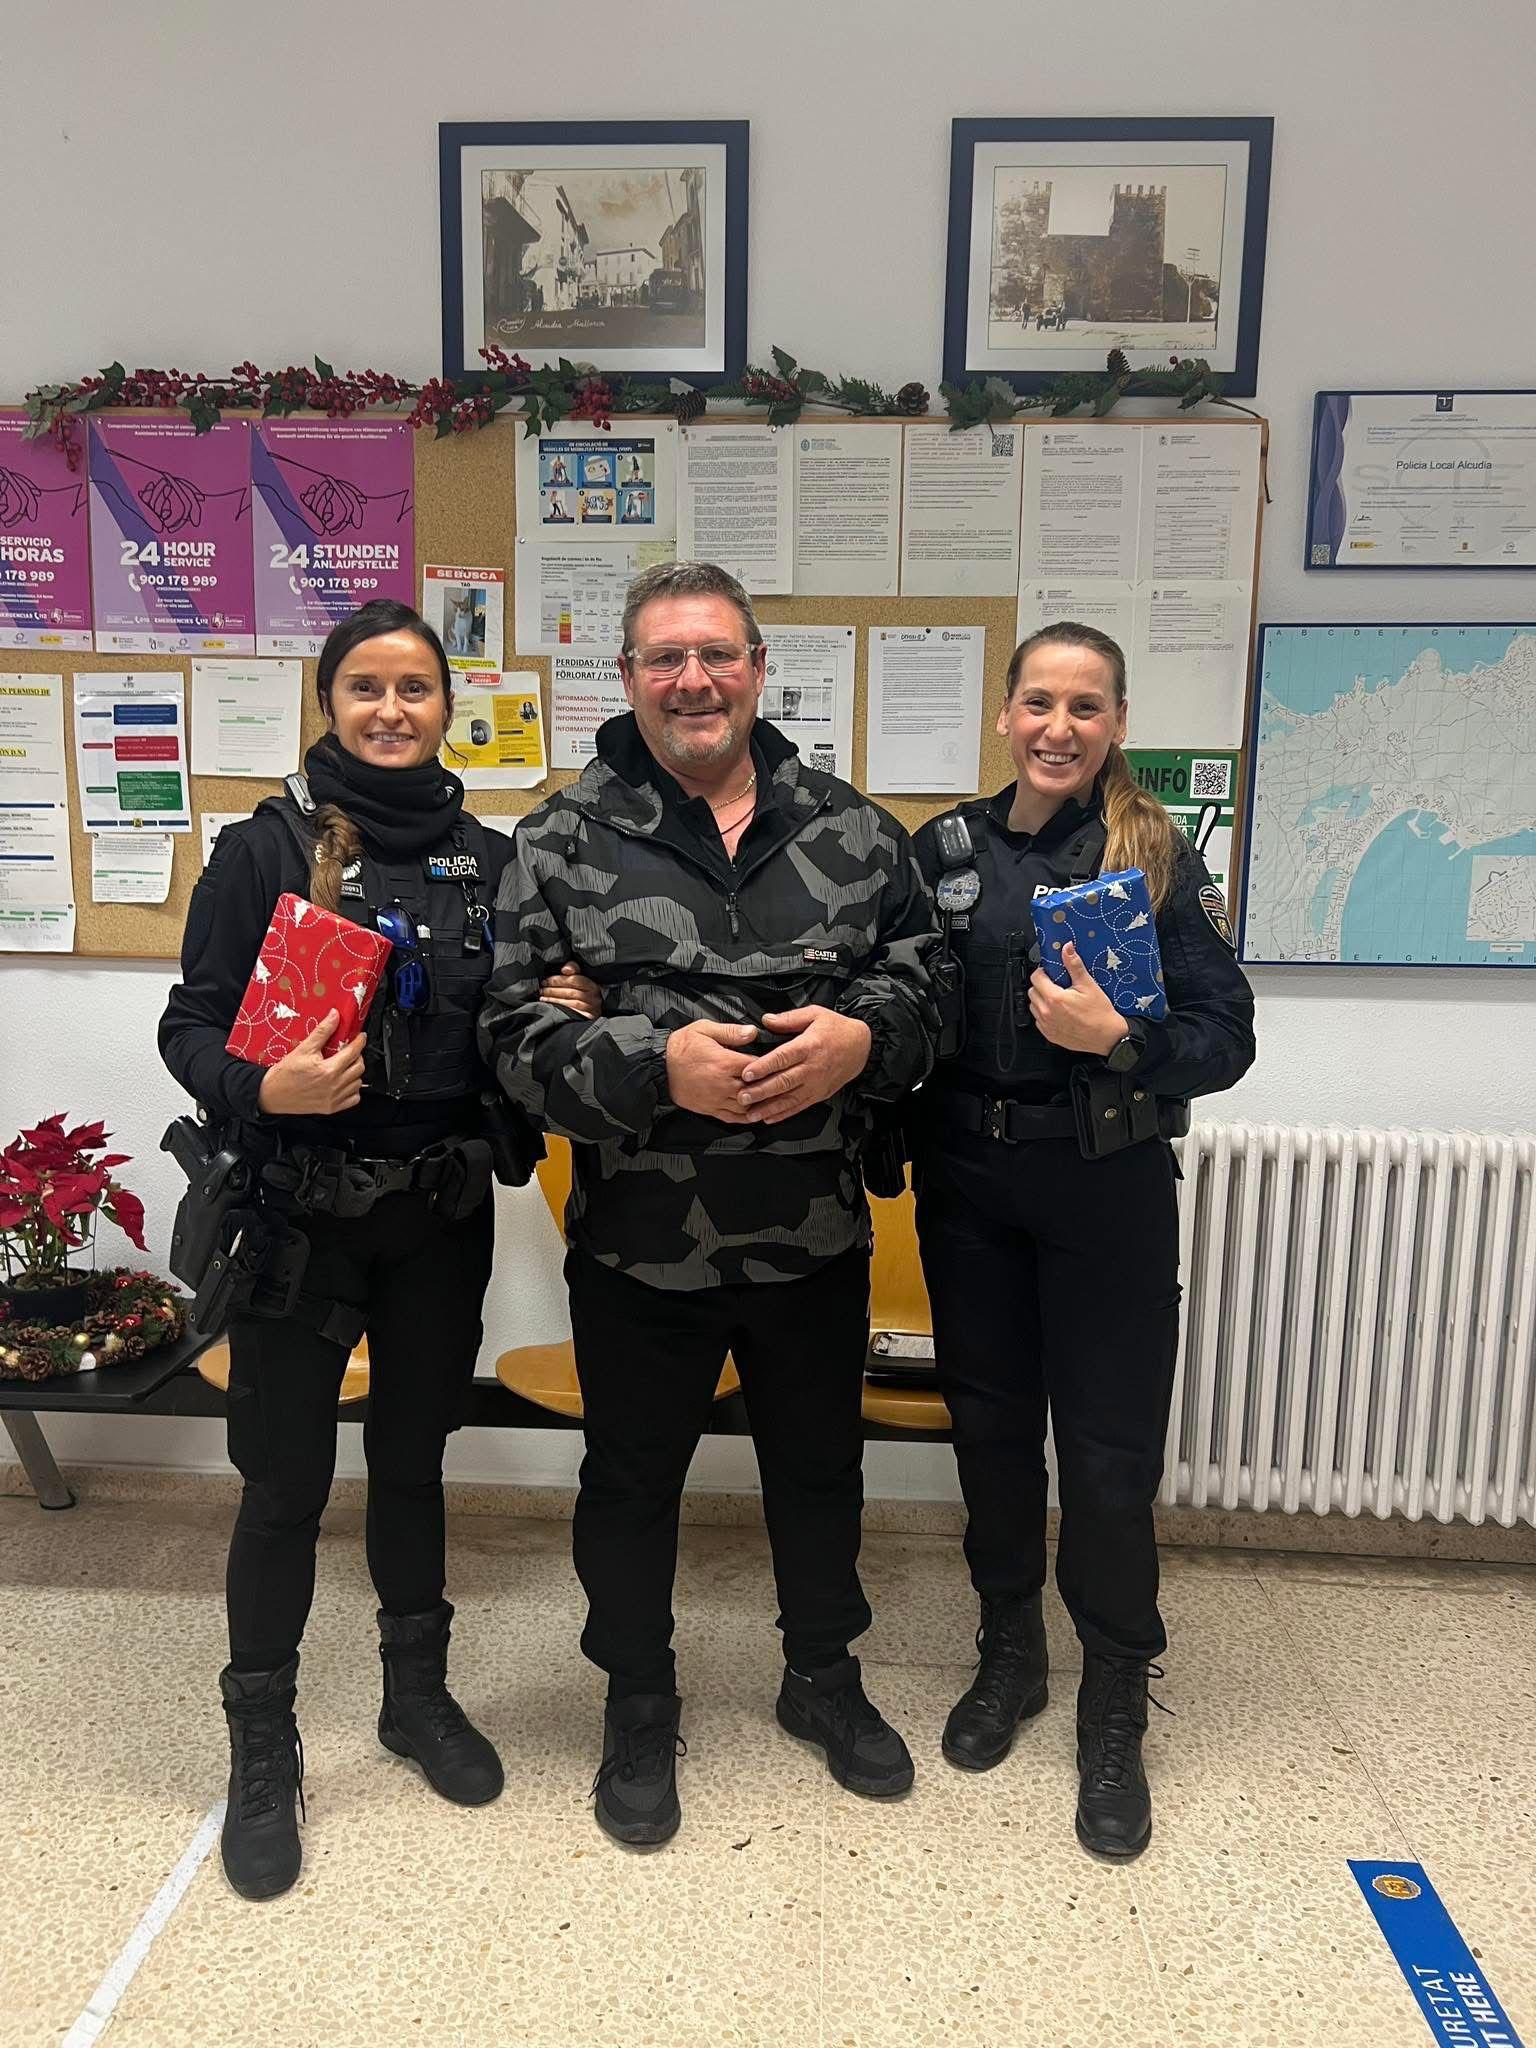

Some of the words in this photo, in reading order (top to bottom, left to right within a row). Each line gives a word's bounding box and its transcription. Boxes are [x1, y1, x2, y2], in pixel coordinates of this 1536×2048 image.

[1430, 460, 1455, 470] Local
[0, 536, 52, 548] SERVICIO
[0, 547, 65, 563] HORAS
[120, 540, 160, 567] 24
[163, 541, 216, 557] HOUR
[313, 544, 399, 559] STUNDEN
[270, 543, 309, 568] 24
[163, 557, 211, 568] SERVICE
[313, 560, 399, 570] ANLAUFSTELLE
[5, 570, 27, 581] 178
[30, 571, 55, 582] 989
[140, 575, 164, 587] 900
[168, 575, 188, 587] 178
[192, 575, 217, 588] 989
[300, 577, 325, 588] 900
[329, 578, 349, 588] 178
[353, 578, 378, 589] 989
[556, 658, 594, 668] PERDIDAS
[556, 669, 595, 680] FÖRLORAT
[9, 688, 40, 696] PERMISO
[428, 855, 477, 868] POLICIA
[445, 865, 479, 878] LOCAL
[1448, 1971, 1500, 2023] HERE
